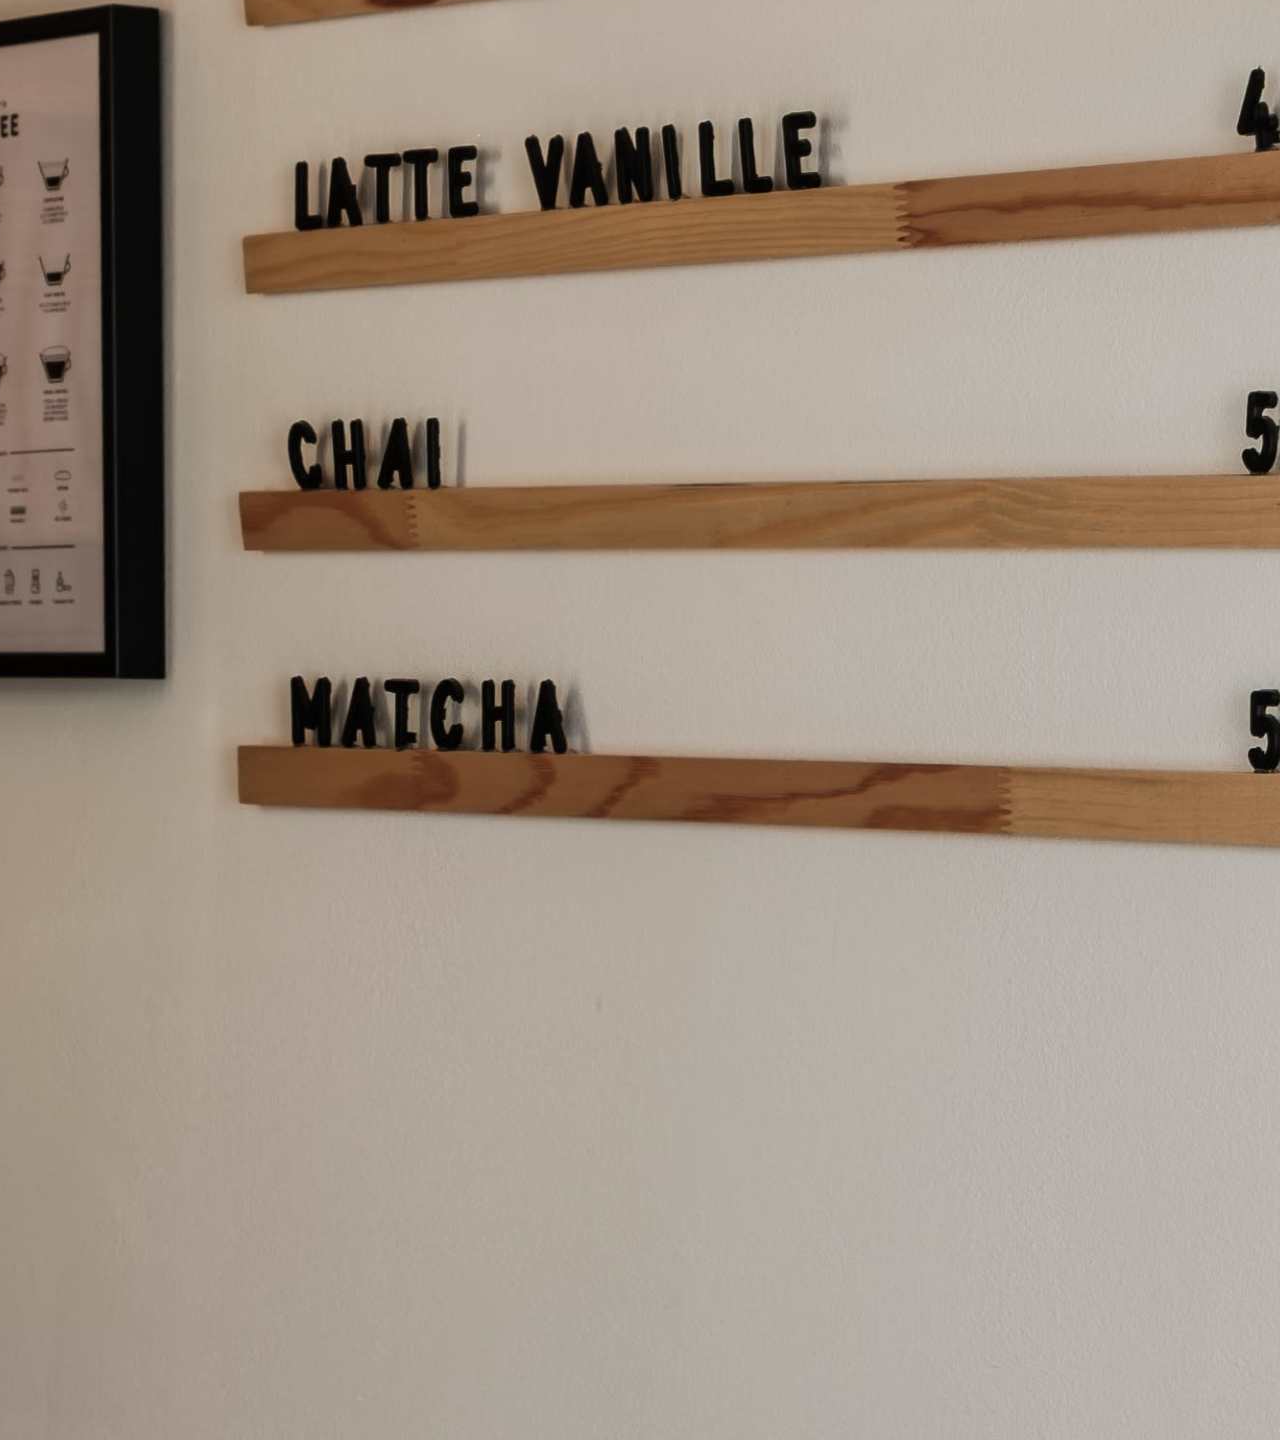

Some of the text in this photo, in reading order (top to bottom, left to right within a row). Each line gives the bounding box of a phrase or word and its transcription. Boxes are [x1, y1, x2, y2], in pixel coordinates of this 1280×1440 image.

[295, 66, 1280, 231] LATTE VANILLE 4
[288, 390, 1280, 491] CHAI 5
[290, 676, 568, 754] MATCHA
